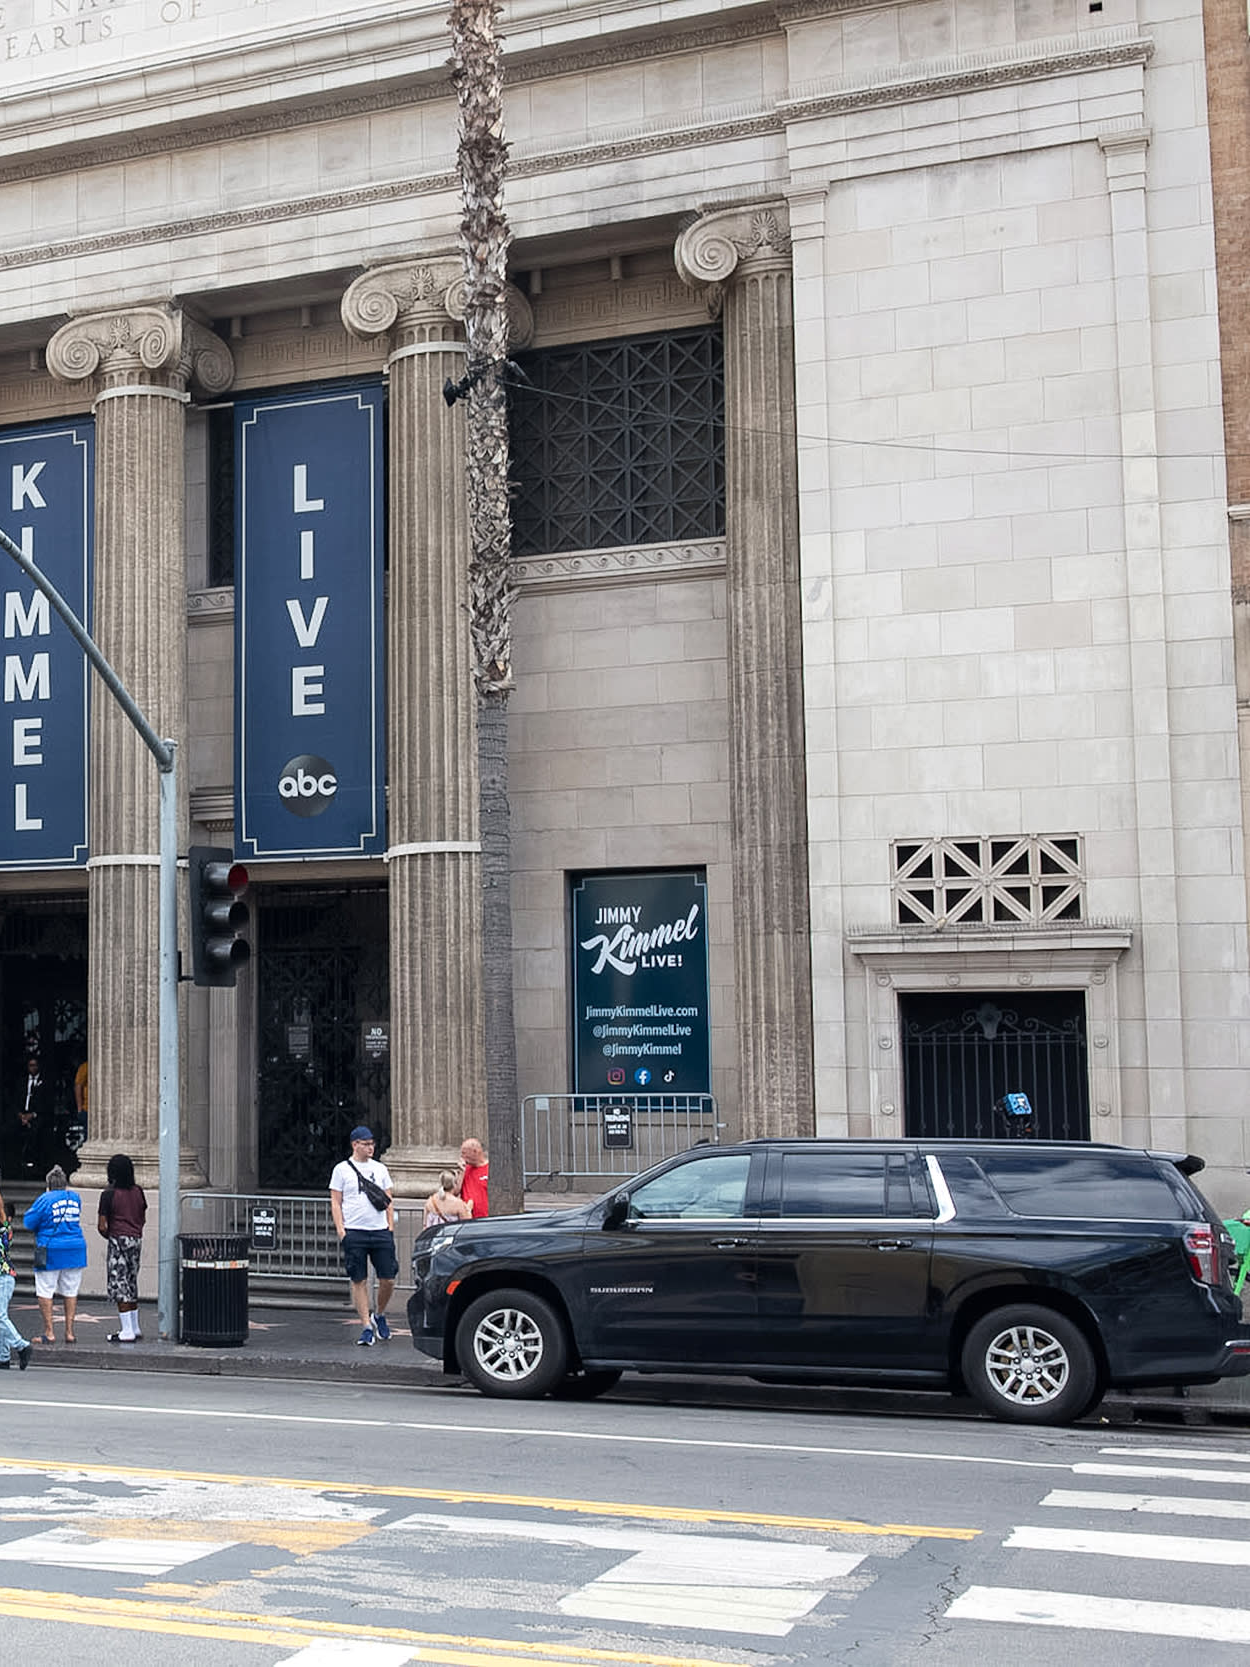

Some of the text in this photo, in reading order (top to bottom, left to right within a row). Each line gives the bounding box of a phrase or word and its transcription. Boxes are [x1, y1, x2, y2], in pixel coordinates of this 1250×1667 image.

[285, 463, 330, 718] LIVE
[3, 460, 51, 832] KIMMEL
[278, 768, 338, 799] abc
[595, 906, 642, 925] JIMMY
[580, 903, 699, 976] Kimmel
[641, 954, 683, 968] LIVE!
[585, 1004, 698, 1020] JimmyKimmelLive.com
[370, 1027, 383, 1036] NO
[592, 1024, 692, 1039] @JimmyKimmelLive
[602, 1042, 682, 1058] @JimmyKimmel
